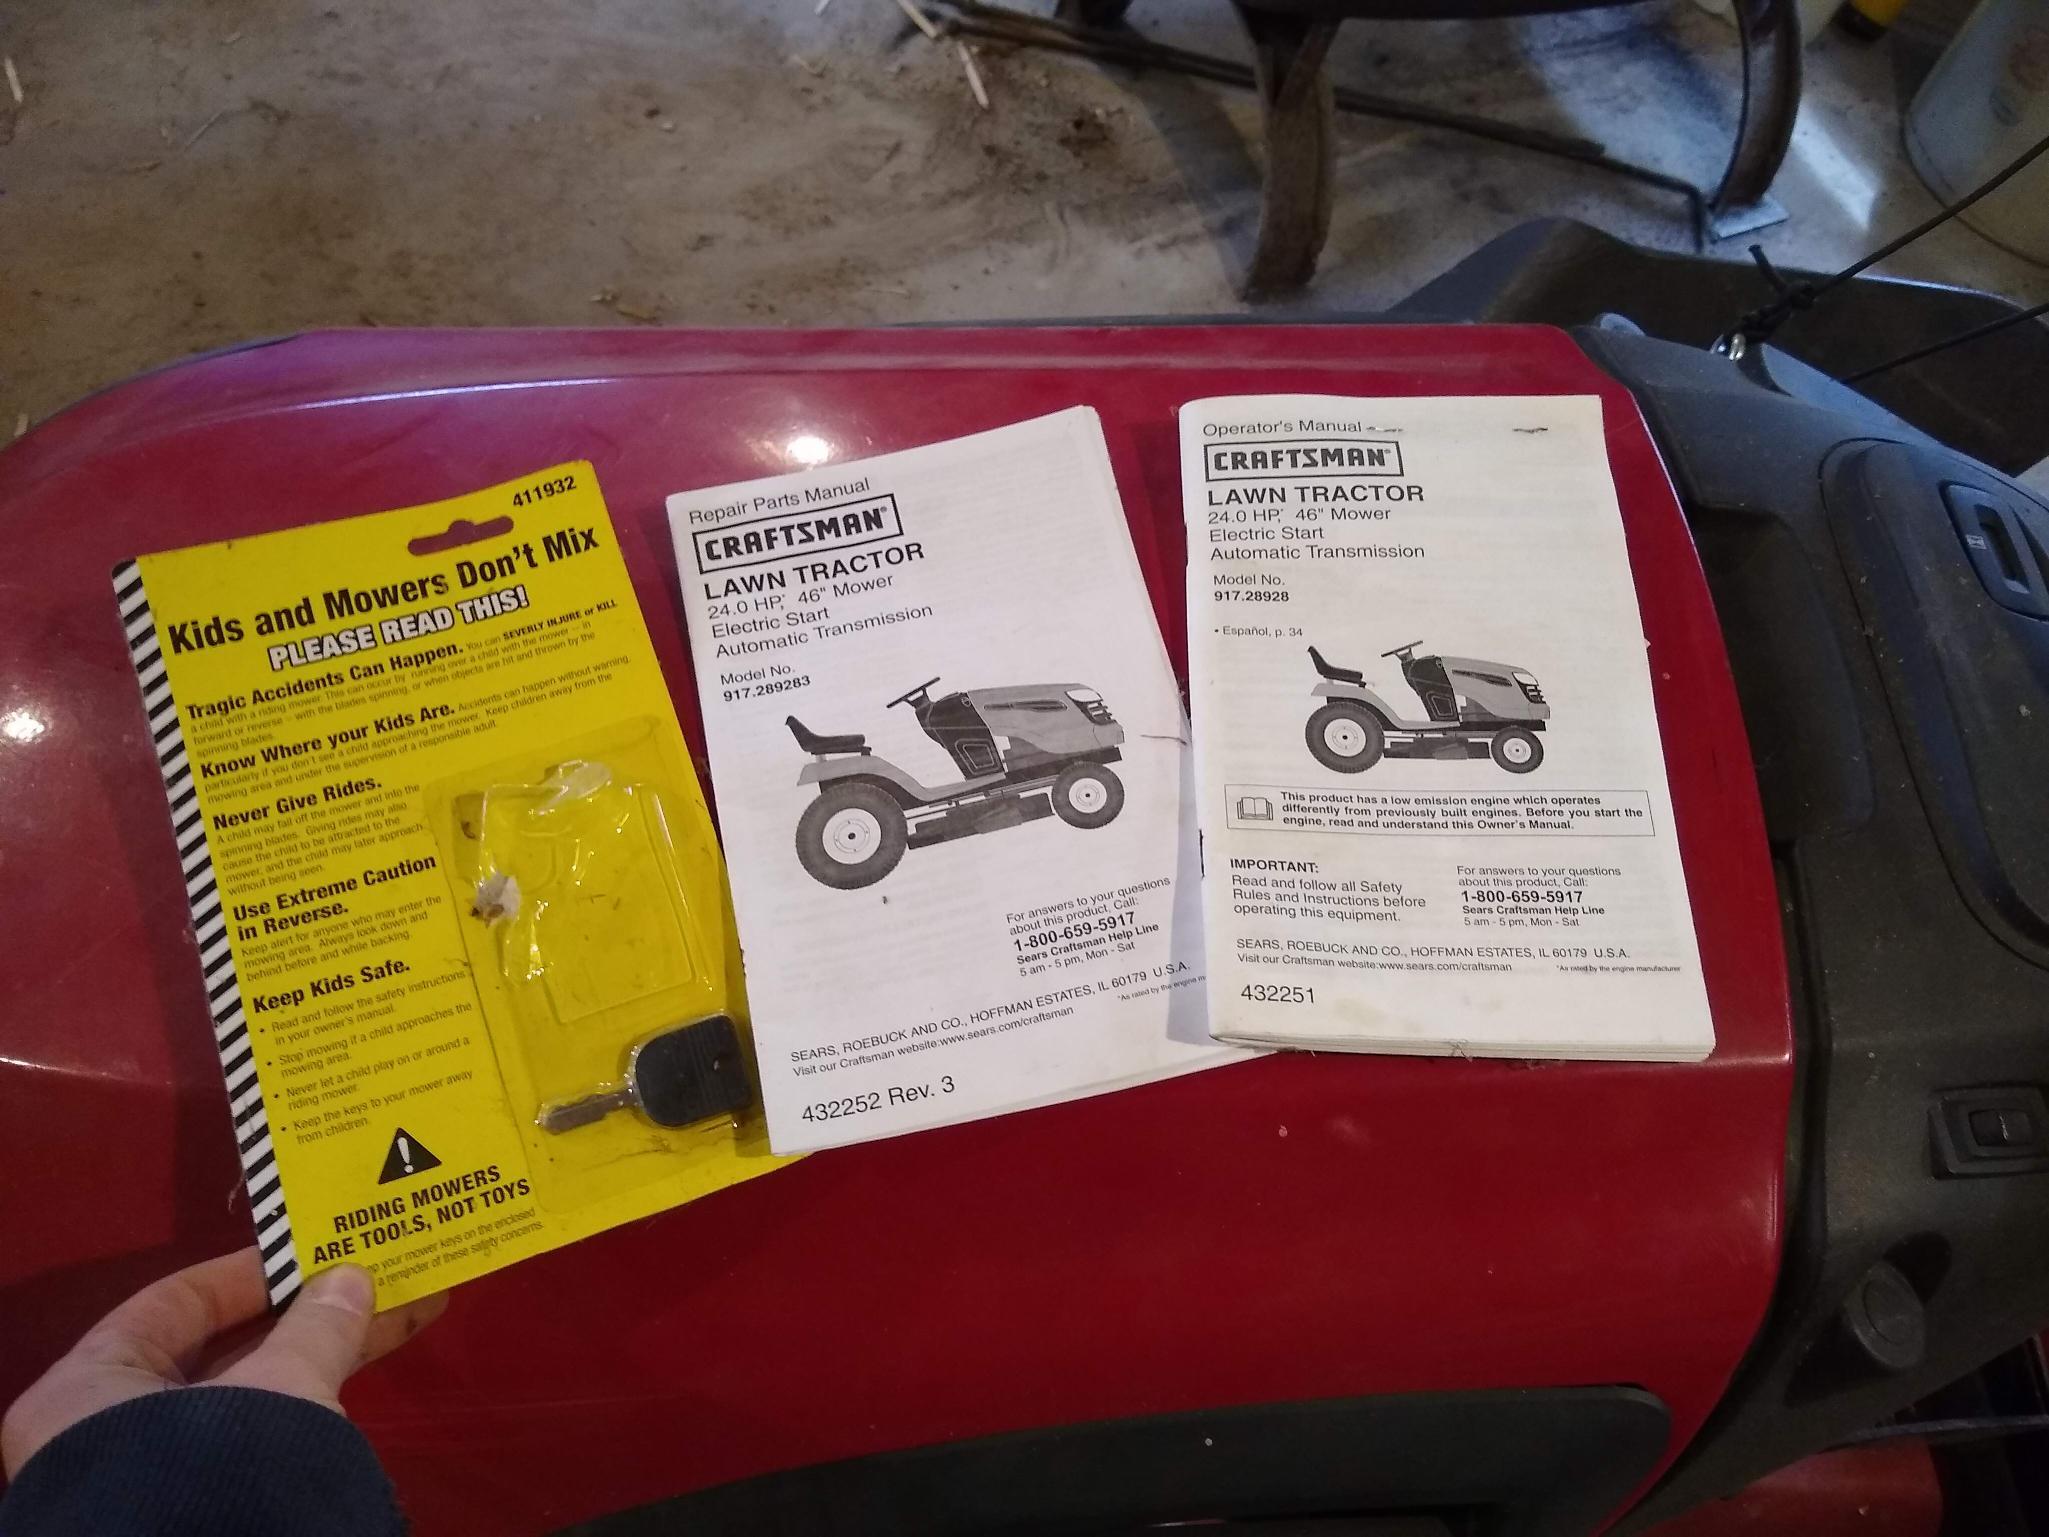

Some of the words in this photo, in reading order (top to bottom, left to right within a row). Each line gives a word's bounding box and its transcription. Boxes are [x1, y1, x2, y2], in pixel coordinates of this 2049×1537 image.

[1202, 419, 1293, 439] Operator's
[1298, 419, 1362, 433] Manual
[512, 475, 577, 507] 411932
[688, 501, 748, 525] Repair
[752, 493, 800, 512] Parts
[804, 476, 870, 503] Manual
[1207, 486, 1286, 507] LAWN
[1293, 484, 1424, 503] TRACTOR
[1207, 509, 1247, 525] 24.0
[1295, 507, 1324, 521] 46"
[1330, 507, 1391, 520] Mower
[1209, 526, 1276, 543] Electric
[1281, 525, 1325, 540] Start
[1210, 544, 1301, 561] Automatic
[1304, 543, 1425, 559] Transmission
[703, 569, 786, 600] LAWN
[791, 542, 925, 584] TRACTOR
[1213, 573, 1256, 586] Model
[167, 615, 245, 655] Kids
[254, 596, 316, 636] and
[322, 573, 449, 620] Mowers
[455, 542, 539, 589] Don't
[541, 526, 600, 563] Mix
[707, 599, 749, 620] 24.0
[797, 586, 826, 604] 46"
[832, 575, 893, 598] Mower
[1213, 590, 1289, 602] 917.28928
[266, 622, 379, 673] PLEASE
[377, 604, 456, 646] READ
[454, 583, 530, 625] THIS!
[711, 615, 781, 639] Electric
[785, 606, 829, 627] Start
[716, 631, 809, 658] Automatic
[812, 605, 933, 639] Transmission
[1222, 625, 1272, 638] Español,
[1288, 626, 1303, 637] 34
[184, 695, 247, 720] Tragic
[252, 671, 345, 705] Accidents
[349, 662, 385, 681] Can
[388, 643, 464, 671] Happen.
[466, 641, 483, 650] You
[484, 636, 501, 647] can
[502, 620, 544, 641] SEVERLY
[546, 610, 580, 628] INJURE
[584, 607, 594, 616] or
[595, 598, 618, 613] KILL
[720, 667, 766, 686] Model
[722, 674, 811, 702] 917.289283
[200, 754, 256, 779] Know
[260, 738, 322, 763] Where
[326, 725, 369, 750] your
[373, 713, 415, 734] Kids
[420, 704, 455, 722] Are.
[458, 693, 503, 712] Accidents
[503, 687, 521, 699] can
[521, 677, 557, 694] happen
[556, 665, 592, 684] without
[212, 805, 270, 830] Never
[275, 793, 318, 814] Give
[322, 777, 382, 802] Rides.
[1279, 791, 1306, 801] This
[1308, 793, 1354, 804] product
[1356, 794, 1378, 804] has
[1380, 796, 1388, 805] a
[1390, 795, 1411, 805] low
[1413, 795, 1467, 806] emission
[1470, 795, 1510, 807] engine
[1512, 795, 1548, 805] which
[1550, 795, 1601, 807] operates
[1281, 803, 1340, 817] differently
[1344, 805, 1371, 816] from
[1375, 807, 1436, 819] previously
[1440, 807, 1468, 817] built
[1525, 807, 1565, 817] Before
[1567, 809, 1590, 819] you
[1594, 808, 1621, 817] start
[1624, 807, 1643, 817] the
[1328, 818, 1354, 827] read
[1357, 818, 1379, 828] and
[1381, 819, 1449, 829] understand
[1451, 820, 1474, 829] this
[1476, 818, 1526, 829] Owner's
[1229, 858, 1319, 874] IMPORTANT:
[232, 901, 271, 922] Use
[275, 878, 358, 910] Extreme
[362, 855, 437, 886] Caution
[1231, 874, 1267, 887] Read
[1270, 878, 1296, 889] and
[1298, 878, 1337, 891] follow
[1341, 880, 1356, 892] all
[1359, 880, 1402, 896] Safety
[1232, 887, 1271, 901] Rules
[1274, 891, 1300, 903] and
[1303, 892, 1380, 907] Instructions
[1382, 895, 1426, 908] before
[1461, 889, 1583, 903] 1-800-659-5917
[1006, 912, 1025, 924] For
[1028, 900, 1075, 919] answers
[1076, 897, 1088, 907] to
[1089, 890, 1118, 906] your
[1117, 877, 1171, 901] questions
[1233, 903, 1297, 919] operating
[1299, 905, 1324, 918] this
[237, 925, 258, 942] in
[262, 902, 349, 935] Reverse.
[1009, 919, 1042, 936] about
[1043, 914, 1064, 927] this
[1013, 910, 1134, 952] 1-800-659-5917
[1016, 950, 1048, 965] Sears
[1050, 936, 1106, 956] Craftsman
[1107, 929, 1134, 942] Help
[1134, 923, 1159, 935] Line
[252, 988, 305, 1014] Keep
[309, 973, 355, 998] Kids
[359, 959, 410, 983] Safe.
[271, 1015, 299, 1033] Read
[301, 1009, 322, 1024] and
[322, 1002, 354, 1018] follow
[355, 996, 374, 1009] the
[374, 986, 406, 1003] safety
[406, 970, 466, 993] instructions
[1240, 984, 1314, 1004] 432251
[792, 1064, 817, 1077] Visit
[818, 1062, 836, 1073] our
[839, 1049, 895, 1068] Craftsman
[801, 1091, 882, 1122] 432252
[887, 1084, 935, 1106] Rev.
[941, 1075, 955, 1093] 3
[333, 1196, 406, 1234] RIDING
[411, 1164, 501, 1209] MOWERS
[313, 1236, 356, 1265] ARE
[359, 1213, 432, 1249] TOOLS,
[436, 1196, 474, 1224] NOT
[478, 1178, 530, 1208] TOYS
